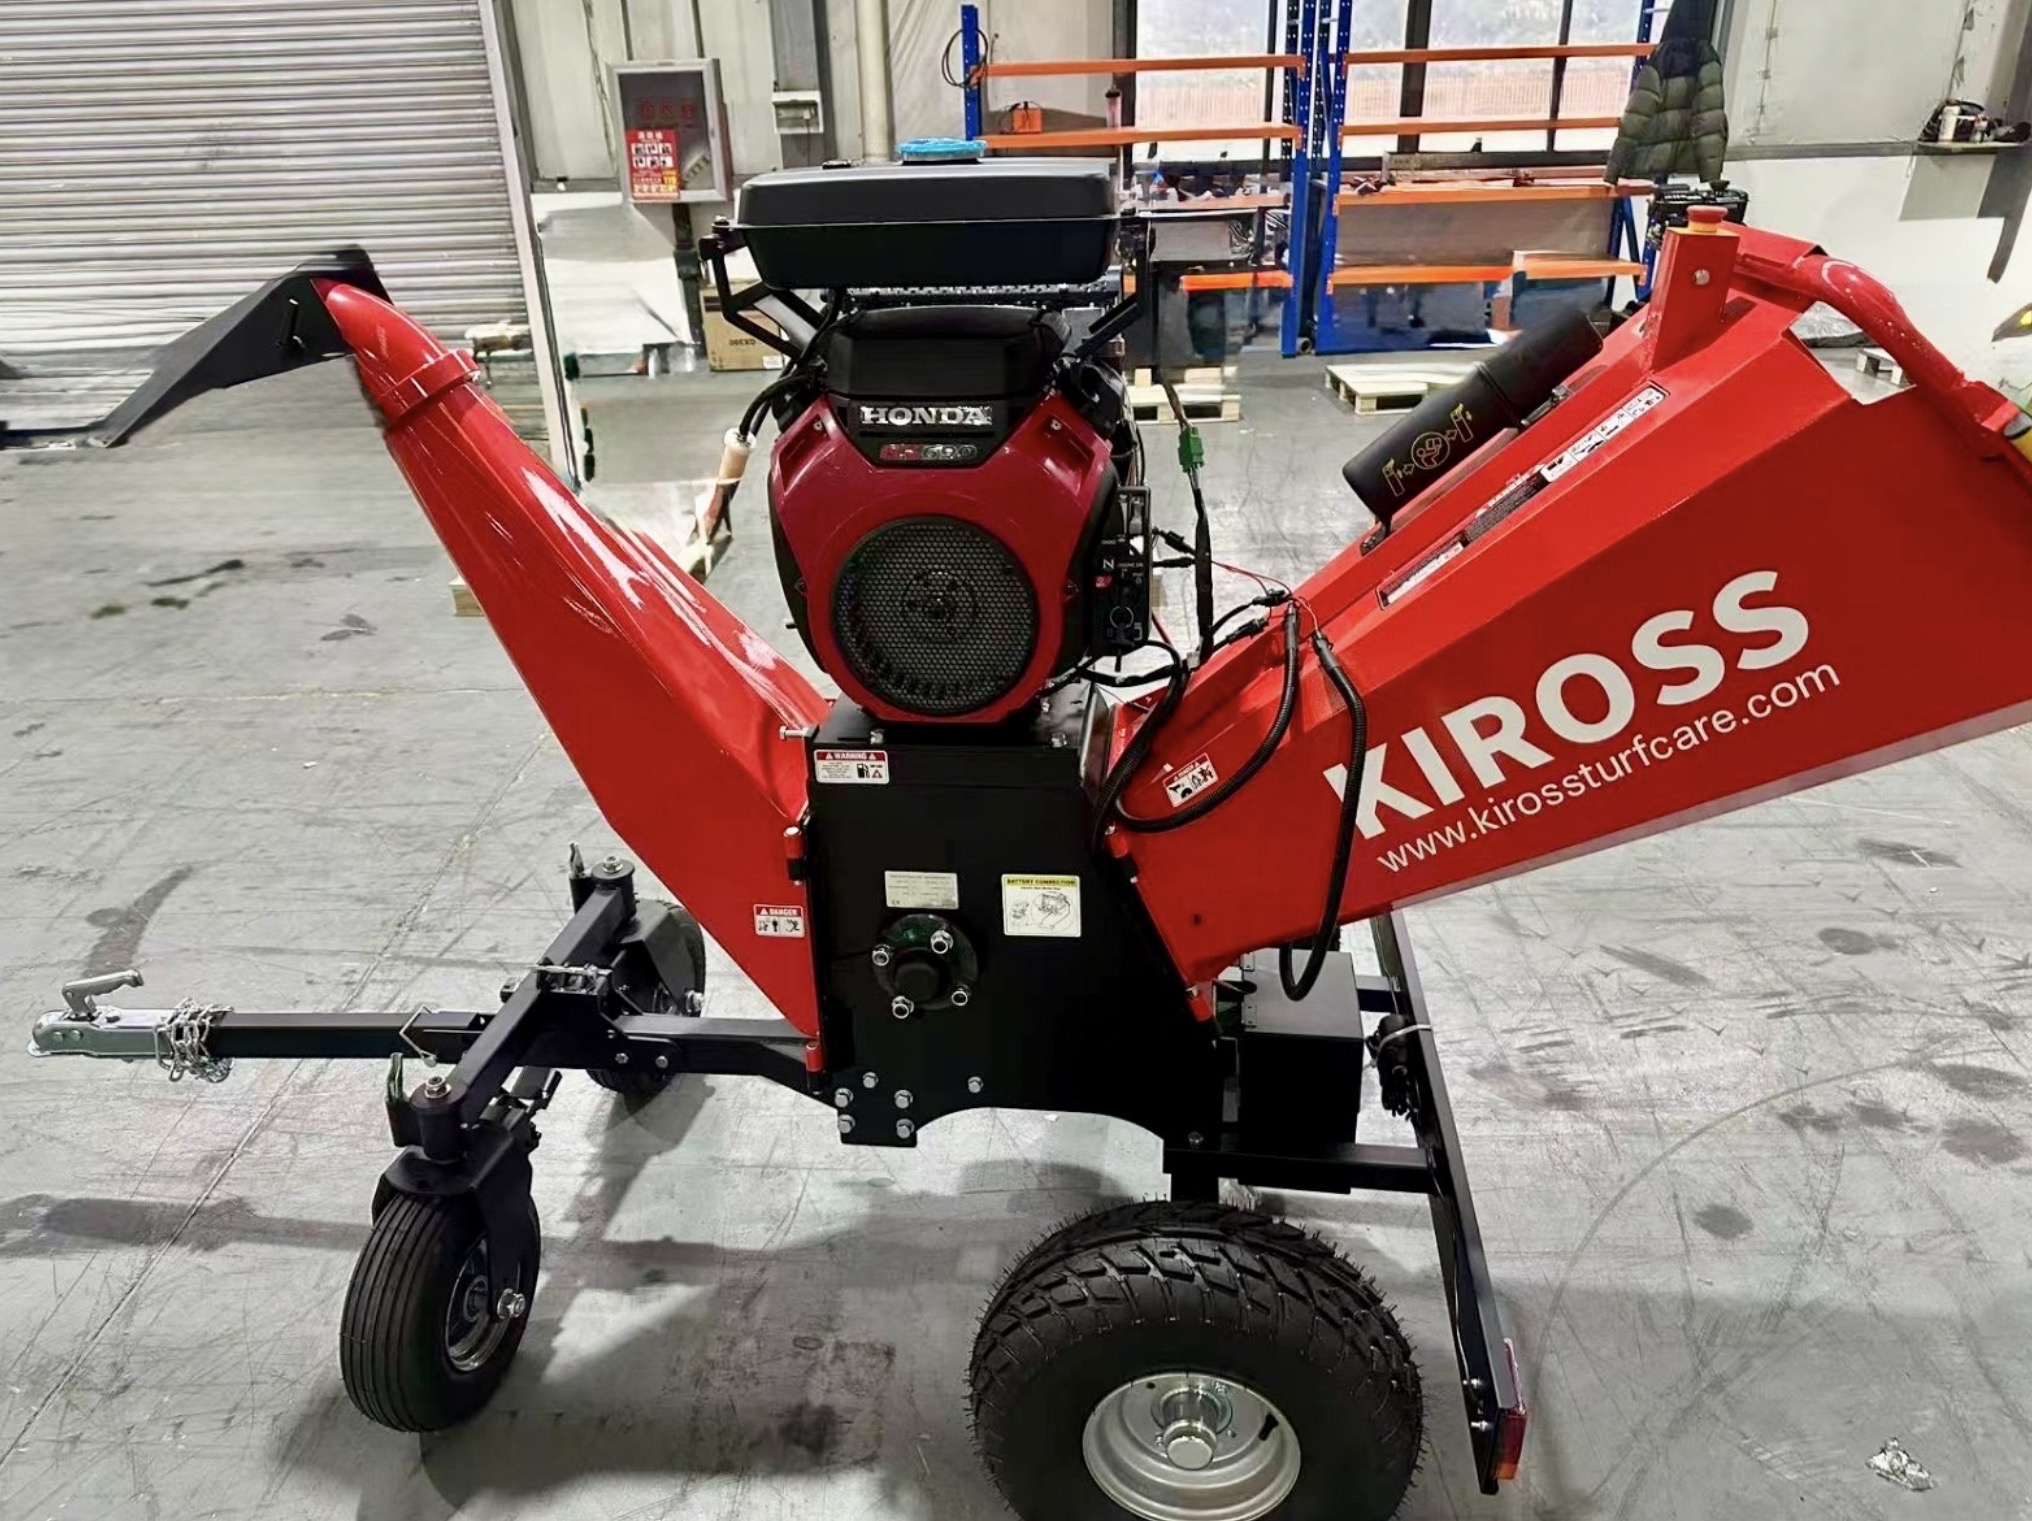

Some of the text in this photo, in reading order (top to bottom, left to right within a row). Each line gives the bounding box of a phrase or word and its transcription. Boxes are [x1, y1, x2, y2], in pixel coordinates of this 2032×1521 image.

[860, 405, 993, 426] HONDA
[1323, 570, 1811, 841] KIROSS
[1375, 660, 1840, 874] www.kirossturfcare.com
